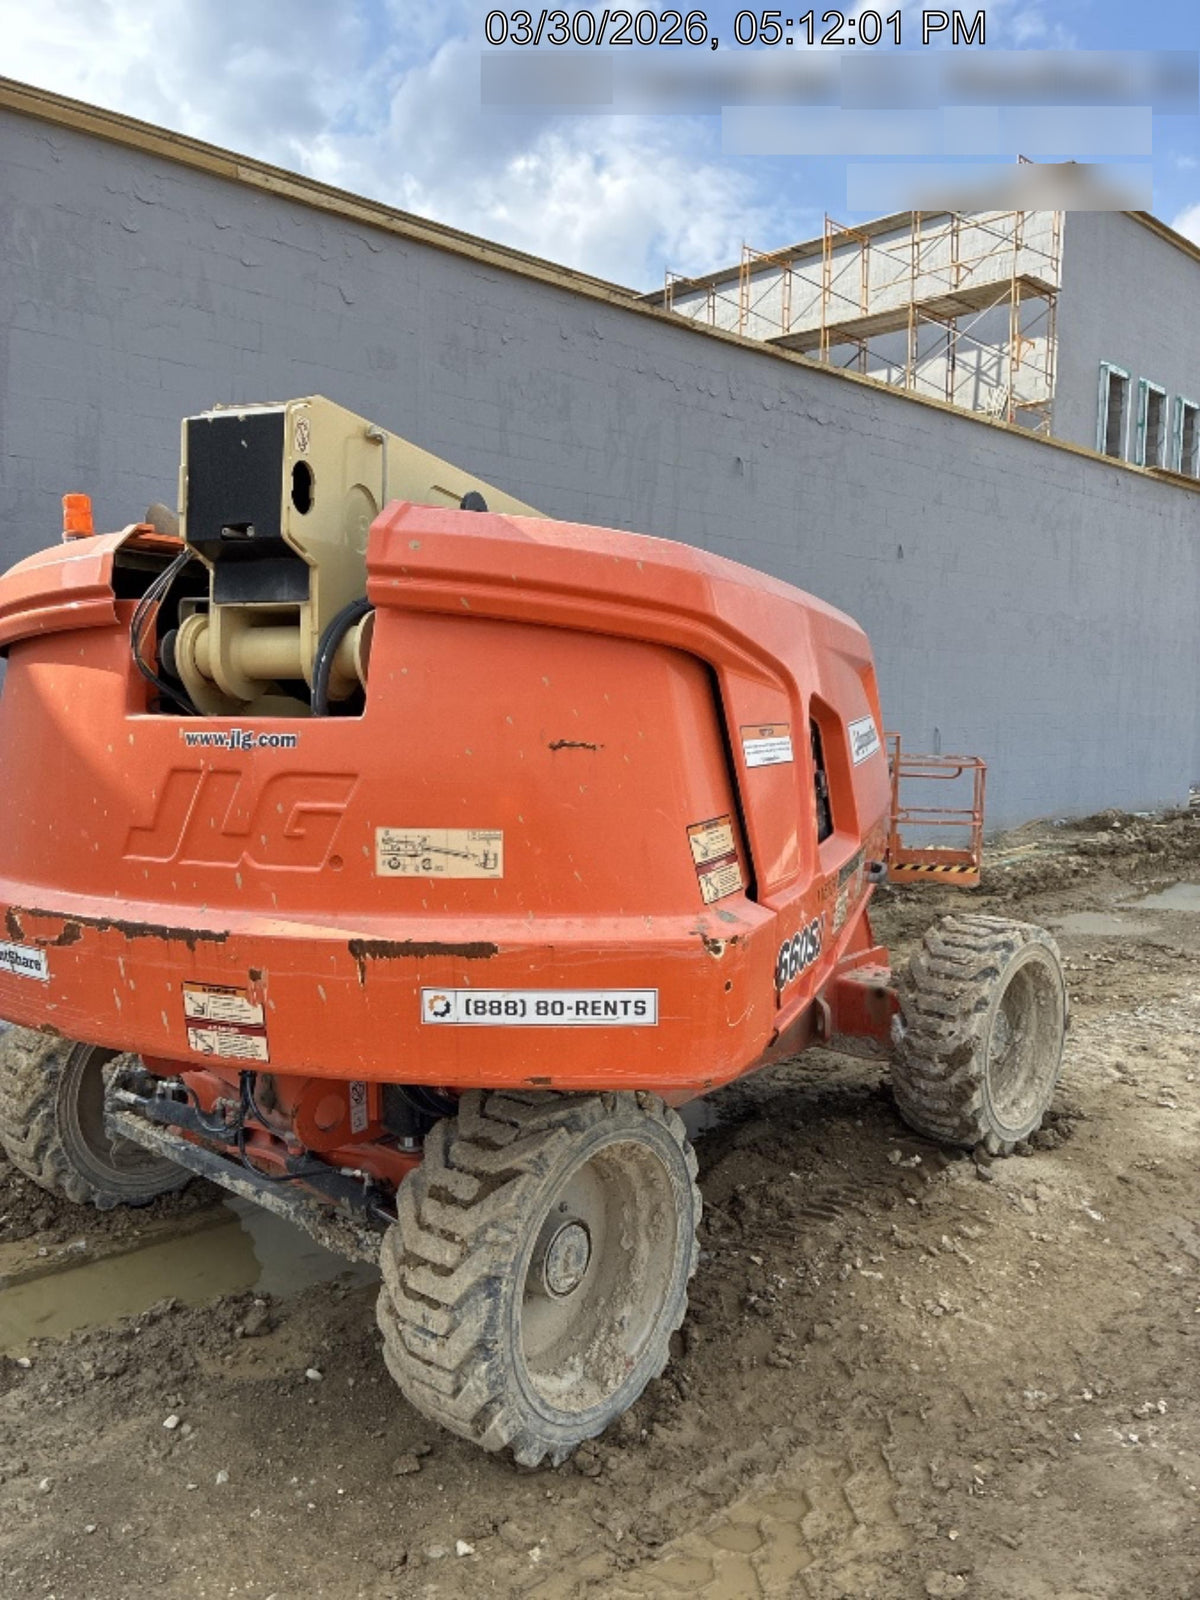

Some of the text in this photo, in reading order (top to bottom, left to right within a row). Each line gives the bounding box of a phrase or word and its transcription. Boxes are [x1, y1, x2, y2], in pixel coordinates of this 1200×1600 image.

[184, 728, 298, 751] www.jlg.com
[122, 767, 361, 873] JLG
[464, 998, 647, 1017] (888) 80-RENTS
